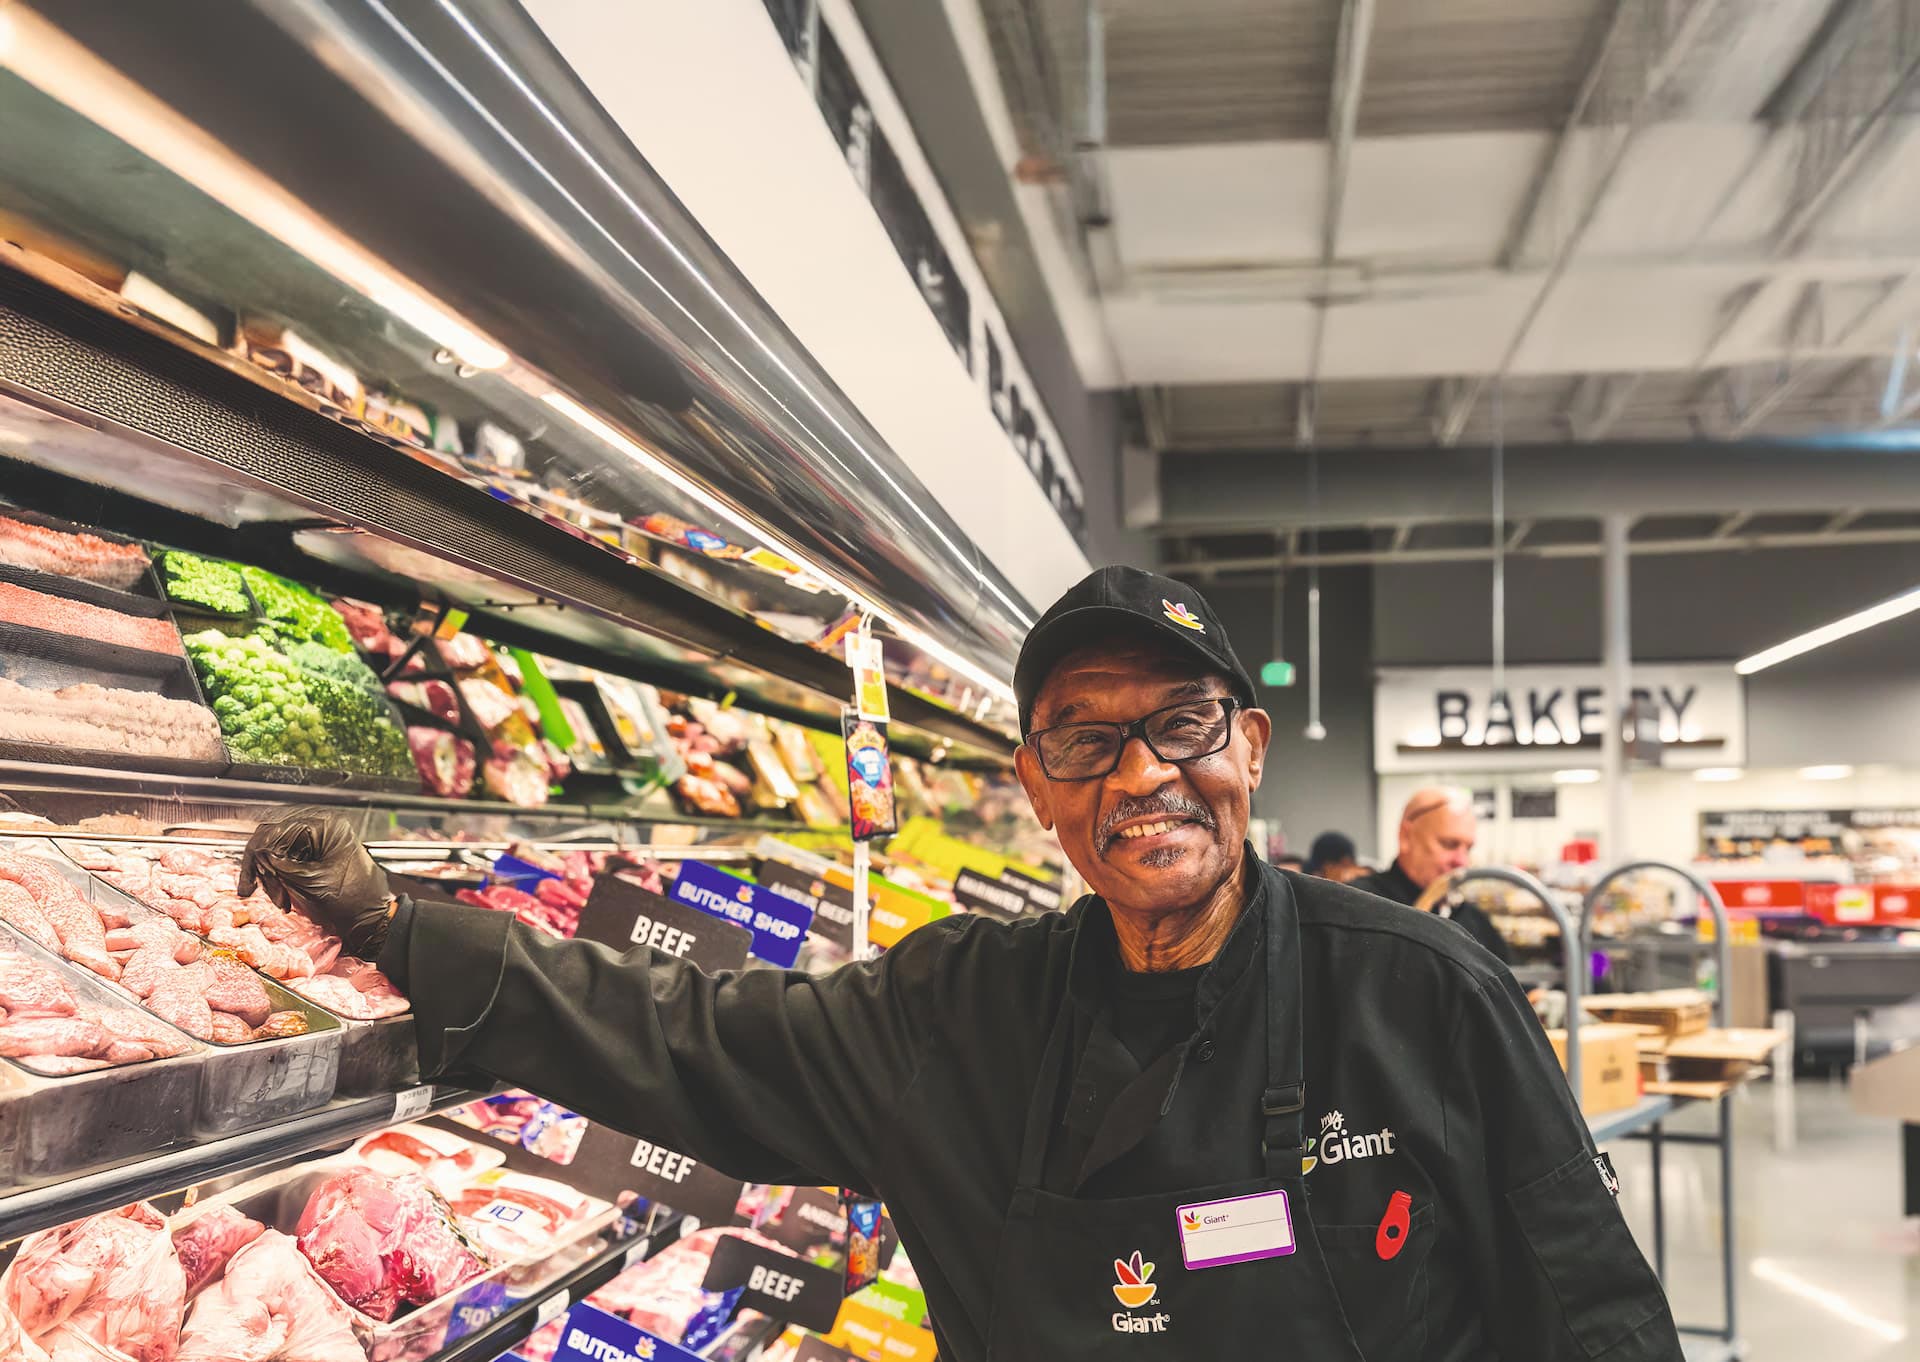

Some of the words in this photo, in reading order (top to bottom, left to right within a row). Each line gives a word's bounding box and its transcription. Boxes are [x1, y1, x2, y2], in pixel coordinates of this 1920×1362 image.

[1436, 687, 1696, 744] BAKEY
[676, 880, 754, 923] BUTCHER
[753, 911, 800, 940] SHOP
[630, 915, 696, 958] BEEF
[630, 1139, 697, 1183] BEEF
[1320, 1128, 1396, 1165] Giant
[748, 1264, 804, 1302] BEEF
